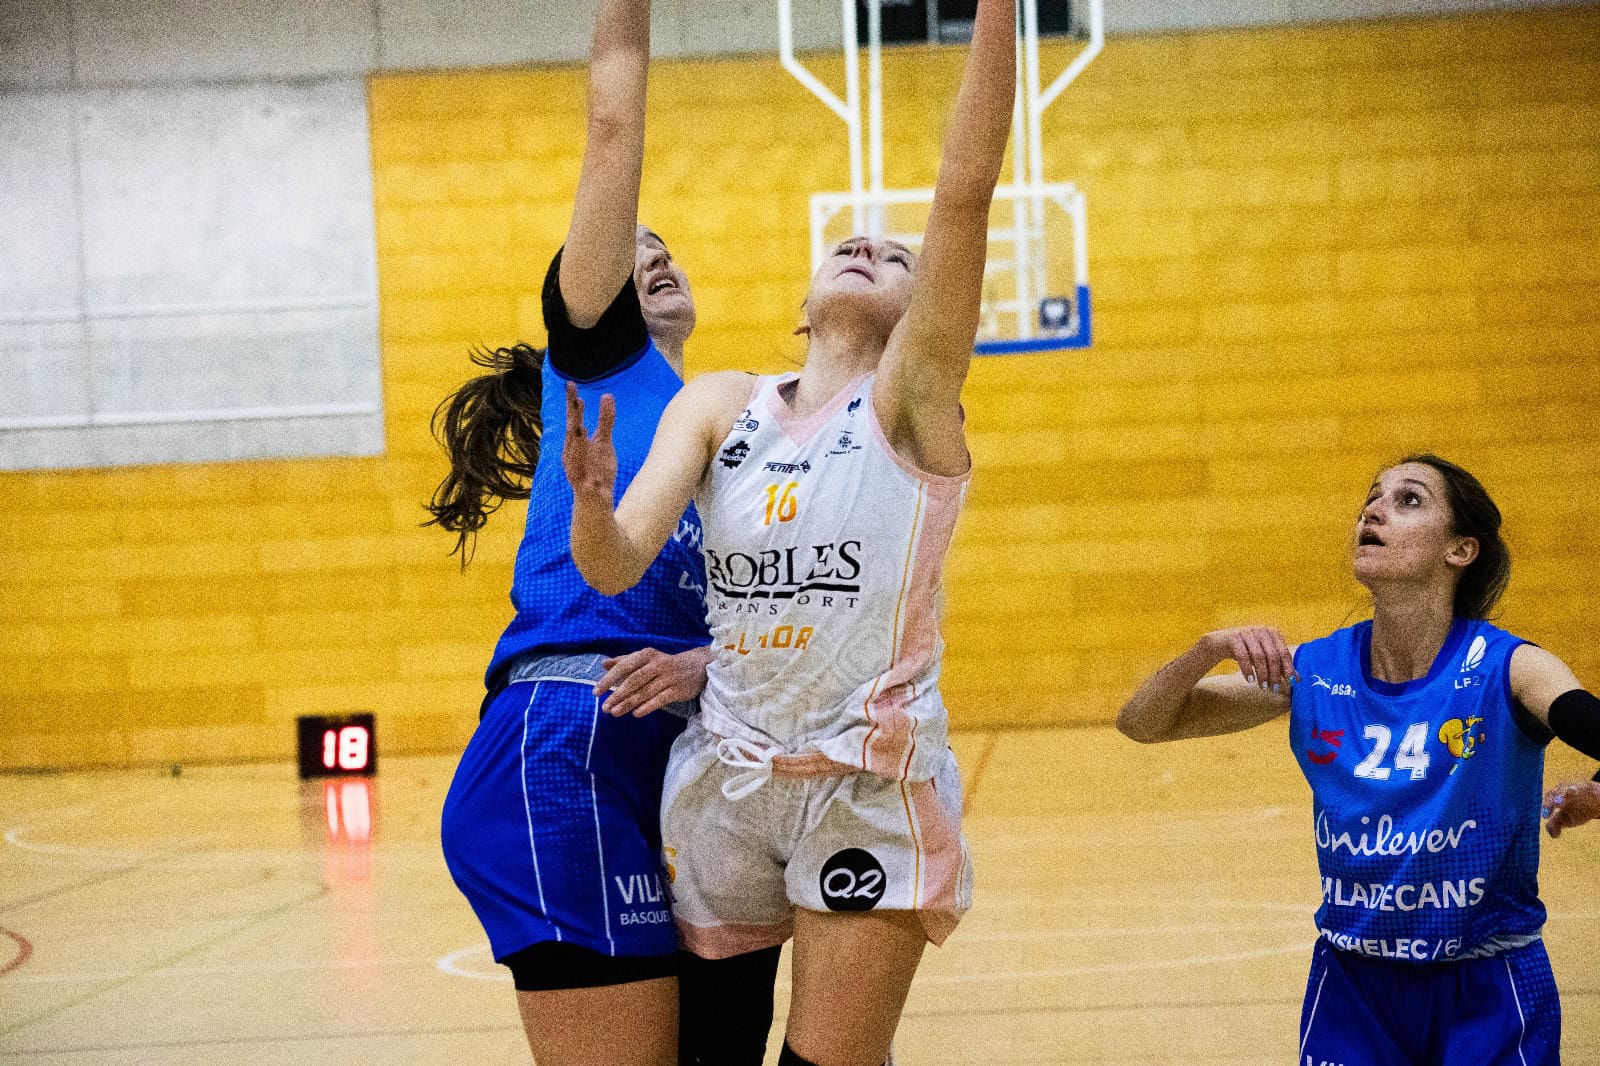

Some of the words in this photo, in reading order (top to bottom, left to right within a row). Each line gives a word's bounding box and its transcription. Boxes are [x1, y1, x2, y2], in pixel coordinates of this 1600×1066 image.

[763, 482, 799, 526] 16
[323, 726, 369, 770] 18
[1354, 720, 1430, 781] 24
[1315, 809, 1477, 857] Unilever
[823, 867, 883, 899] Q2
